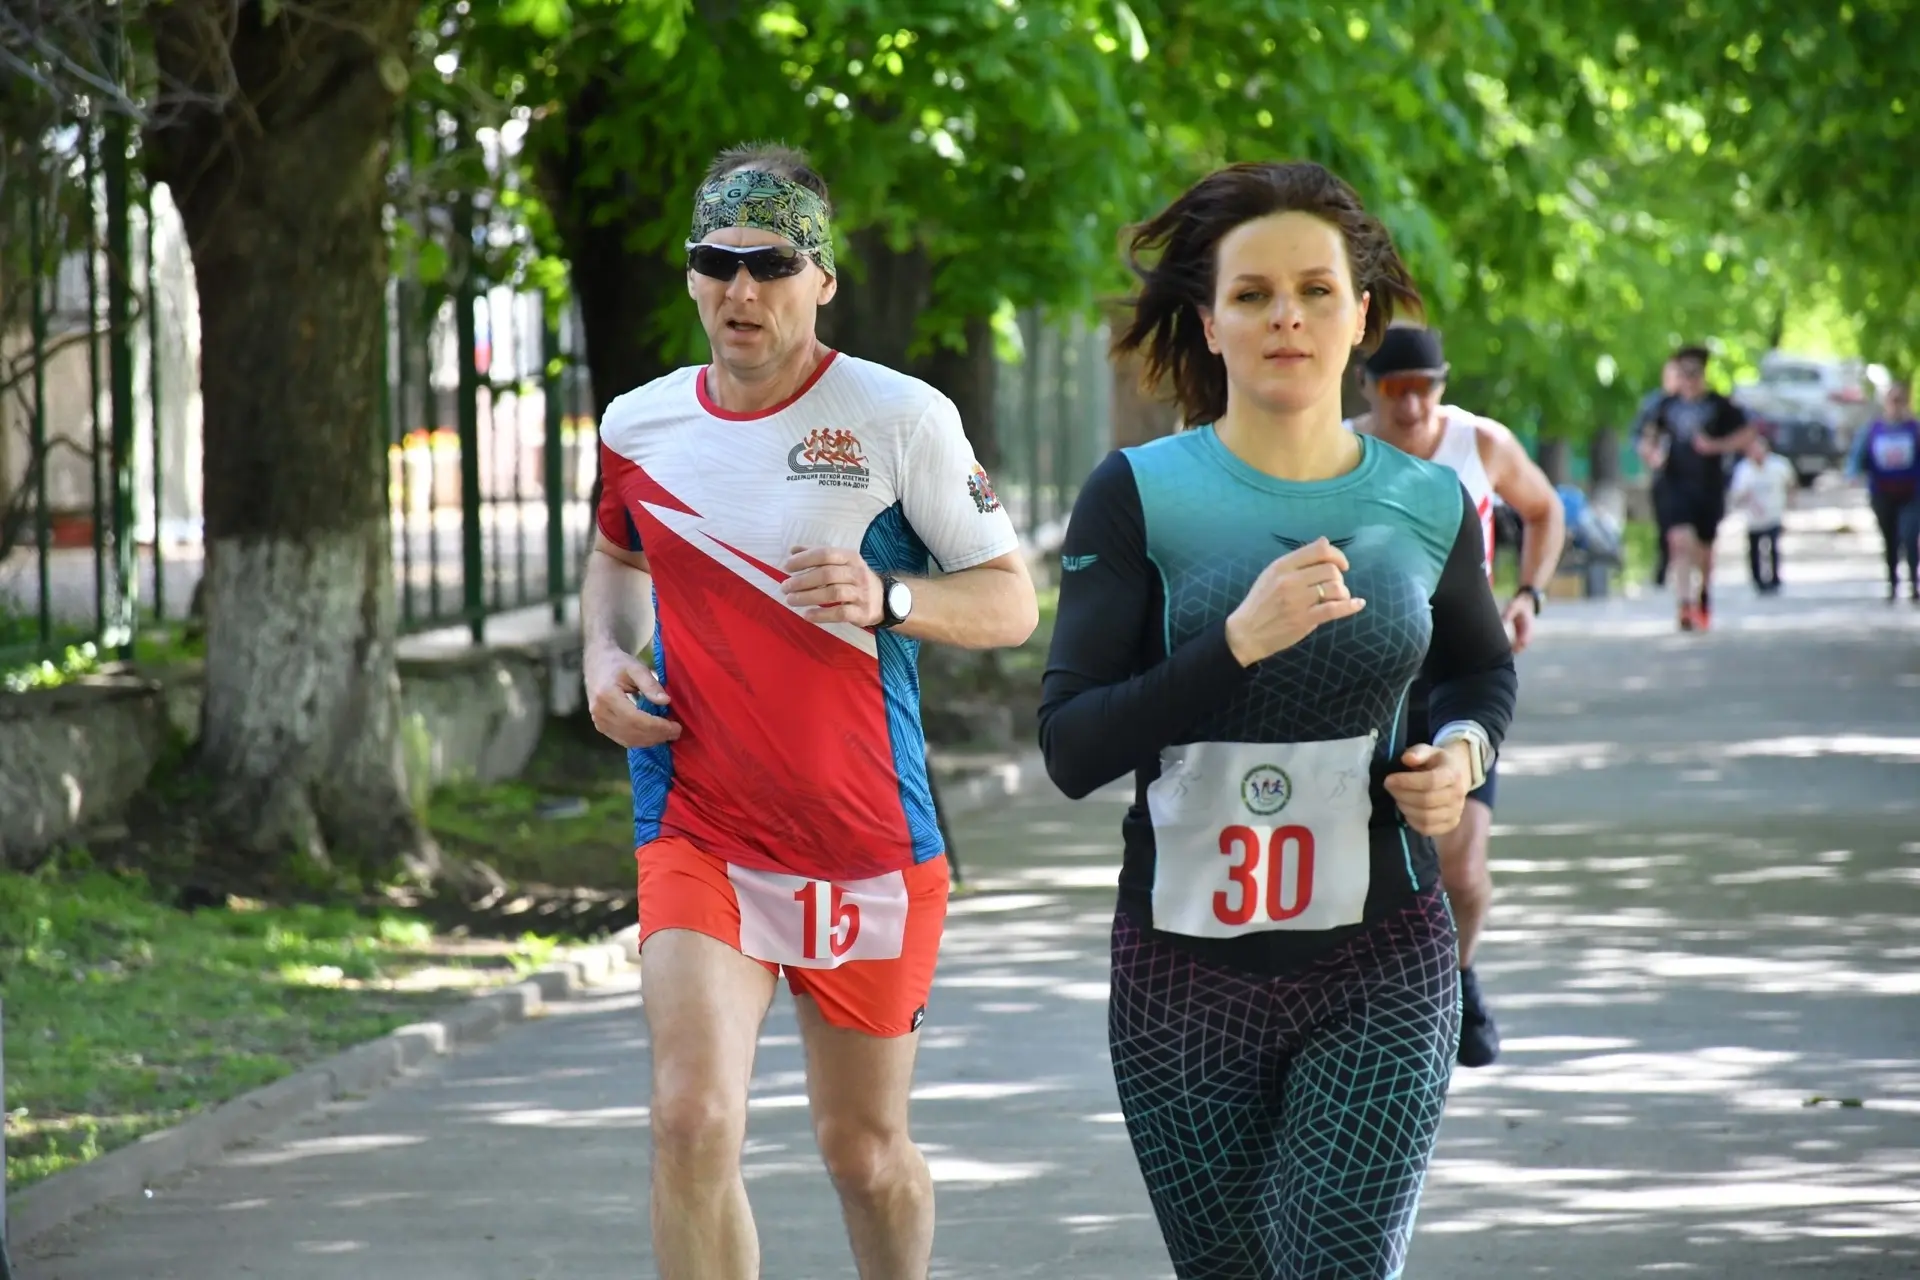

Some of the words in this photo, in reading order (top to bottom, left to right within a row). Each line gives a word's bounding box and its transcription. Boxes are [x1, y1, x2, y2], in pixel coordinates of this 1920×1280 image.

[727, 188, 742, 198] G
[842, 475, 870, 483] АТЛЕТИКИ
[818, 480, 869, 489] РОСТОВ-НА-ДОНУ
[1212, 824, 1315, 926] 30
[793, 881, 861, 959] 15
